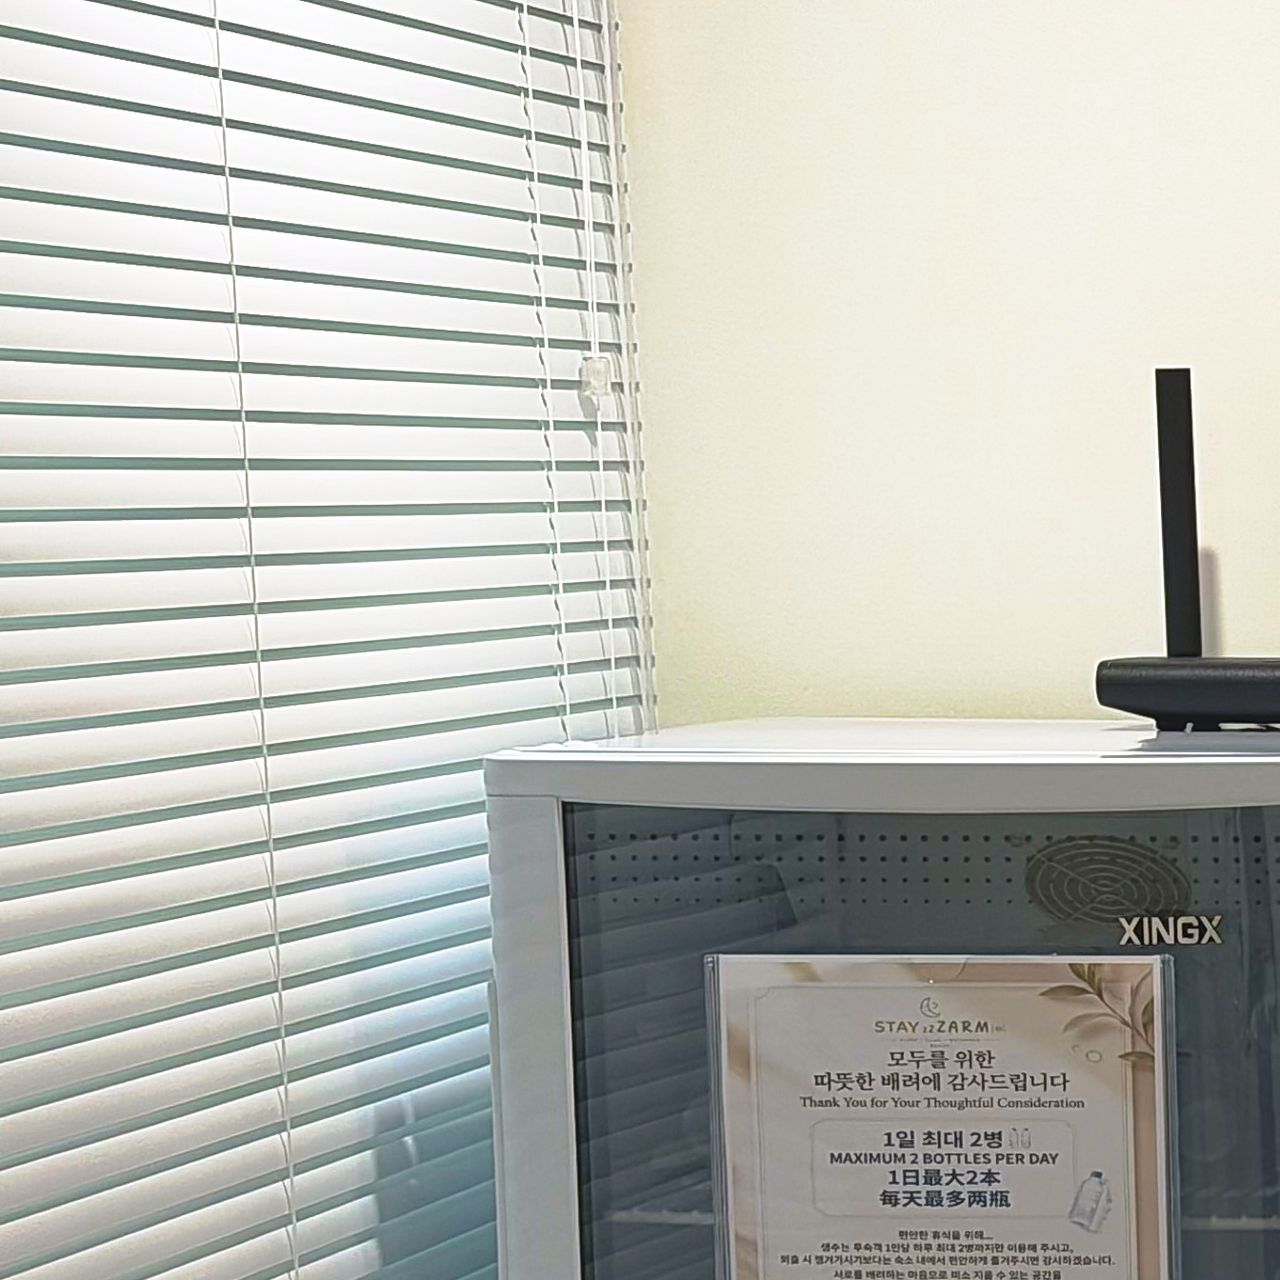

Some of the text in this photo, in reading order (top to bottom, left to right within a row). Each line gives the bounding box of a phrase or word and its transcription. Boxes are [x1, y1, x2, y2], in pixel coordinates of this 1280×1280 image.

[1117, 916, 1224, 945] XINGX
[874, 1021, 919, 1033] STAY
[887, 1050, 996, 1070] 모두를 위한
[814, 1071, 1071, 1092] 따뜻한 배려에 감사드립니다
[799, 1095, 1085, 1111] Thank You for Your Thoughtful Consideration
[883, 1131, 1003, 1149] 1일 최대 2병
[830, 1152, 1060, 1165] MAXIMUM 2 BOTTLES PER DAY
[888, 1169, 1001, 1187] 1日最大2本
[879, 1190, 1011, 1208] 每天最多两瓶
